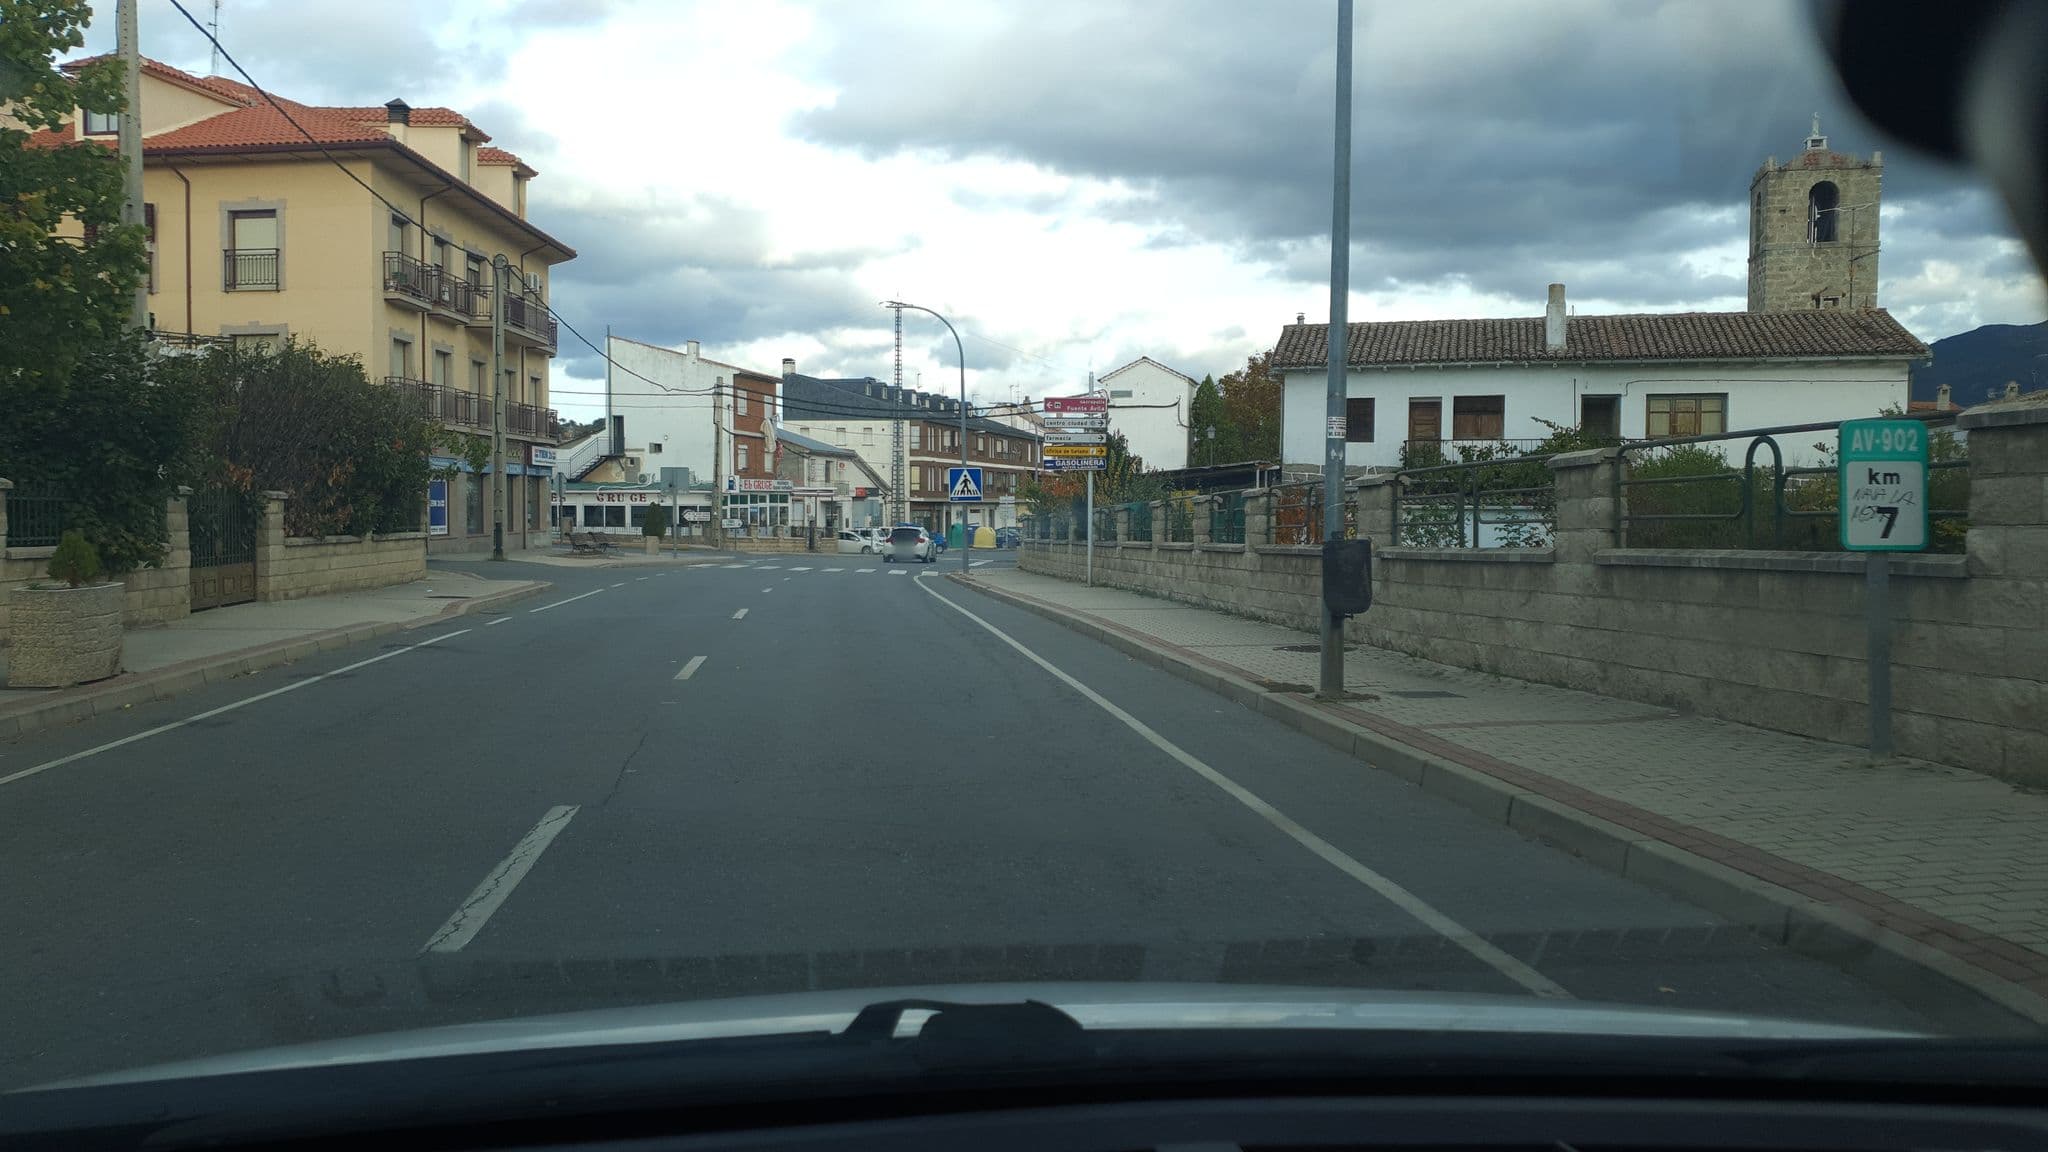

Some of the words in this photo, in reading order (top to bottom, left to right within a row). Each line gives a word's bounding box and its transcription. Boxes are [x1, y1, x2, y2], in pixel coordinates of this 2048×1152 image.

[1852, 428, 1919, 452] AV-902
[1868, 467, 1900, 485] km
[1877, 506, 1899, 539] 7
